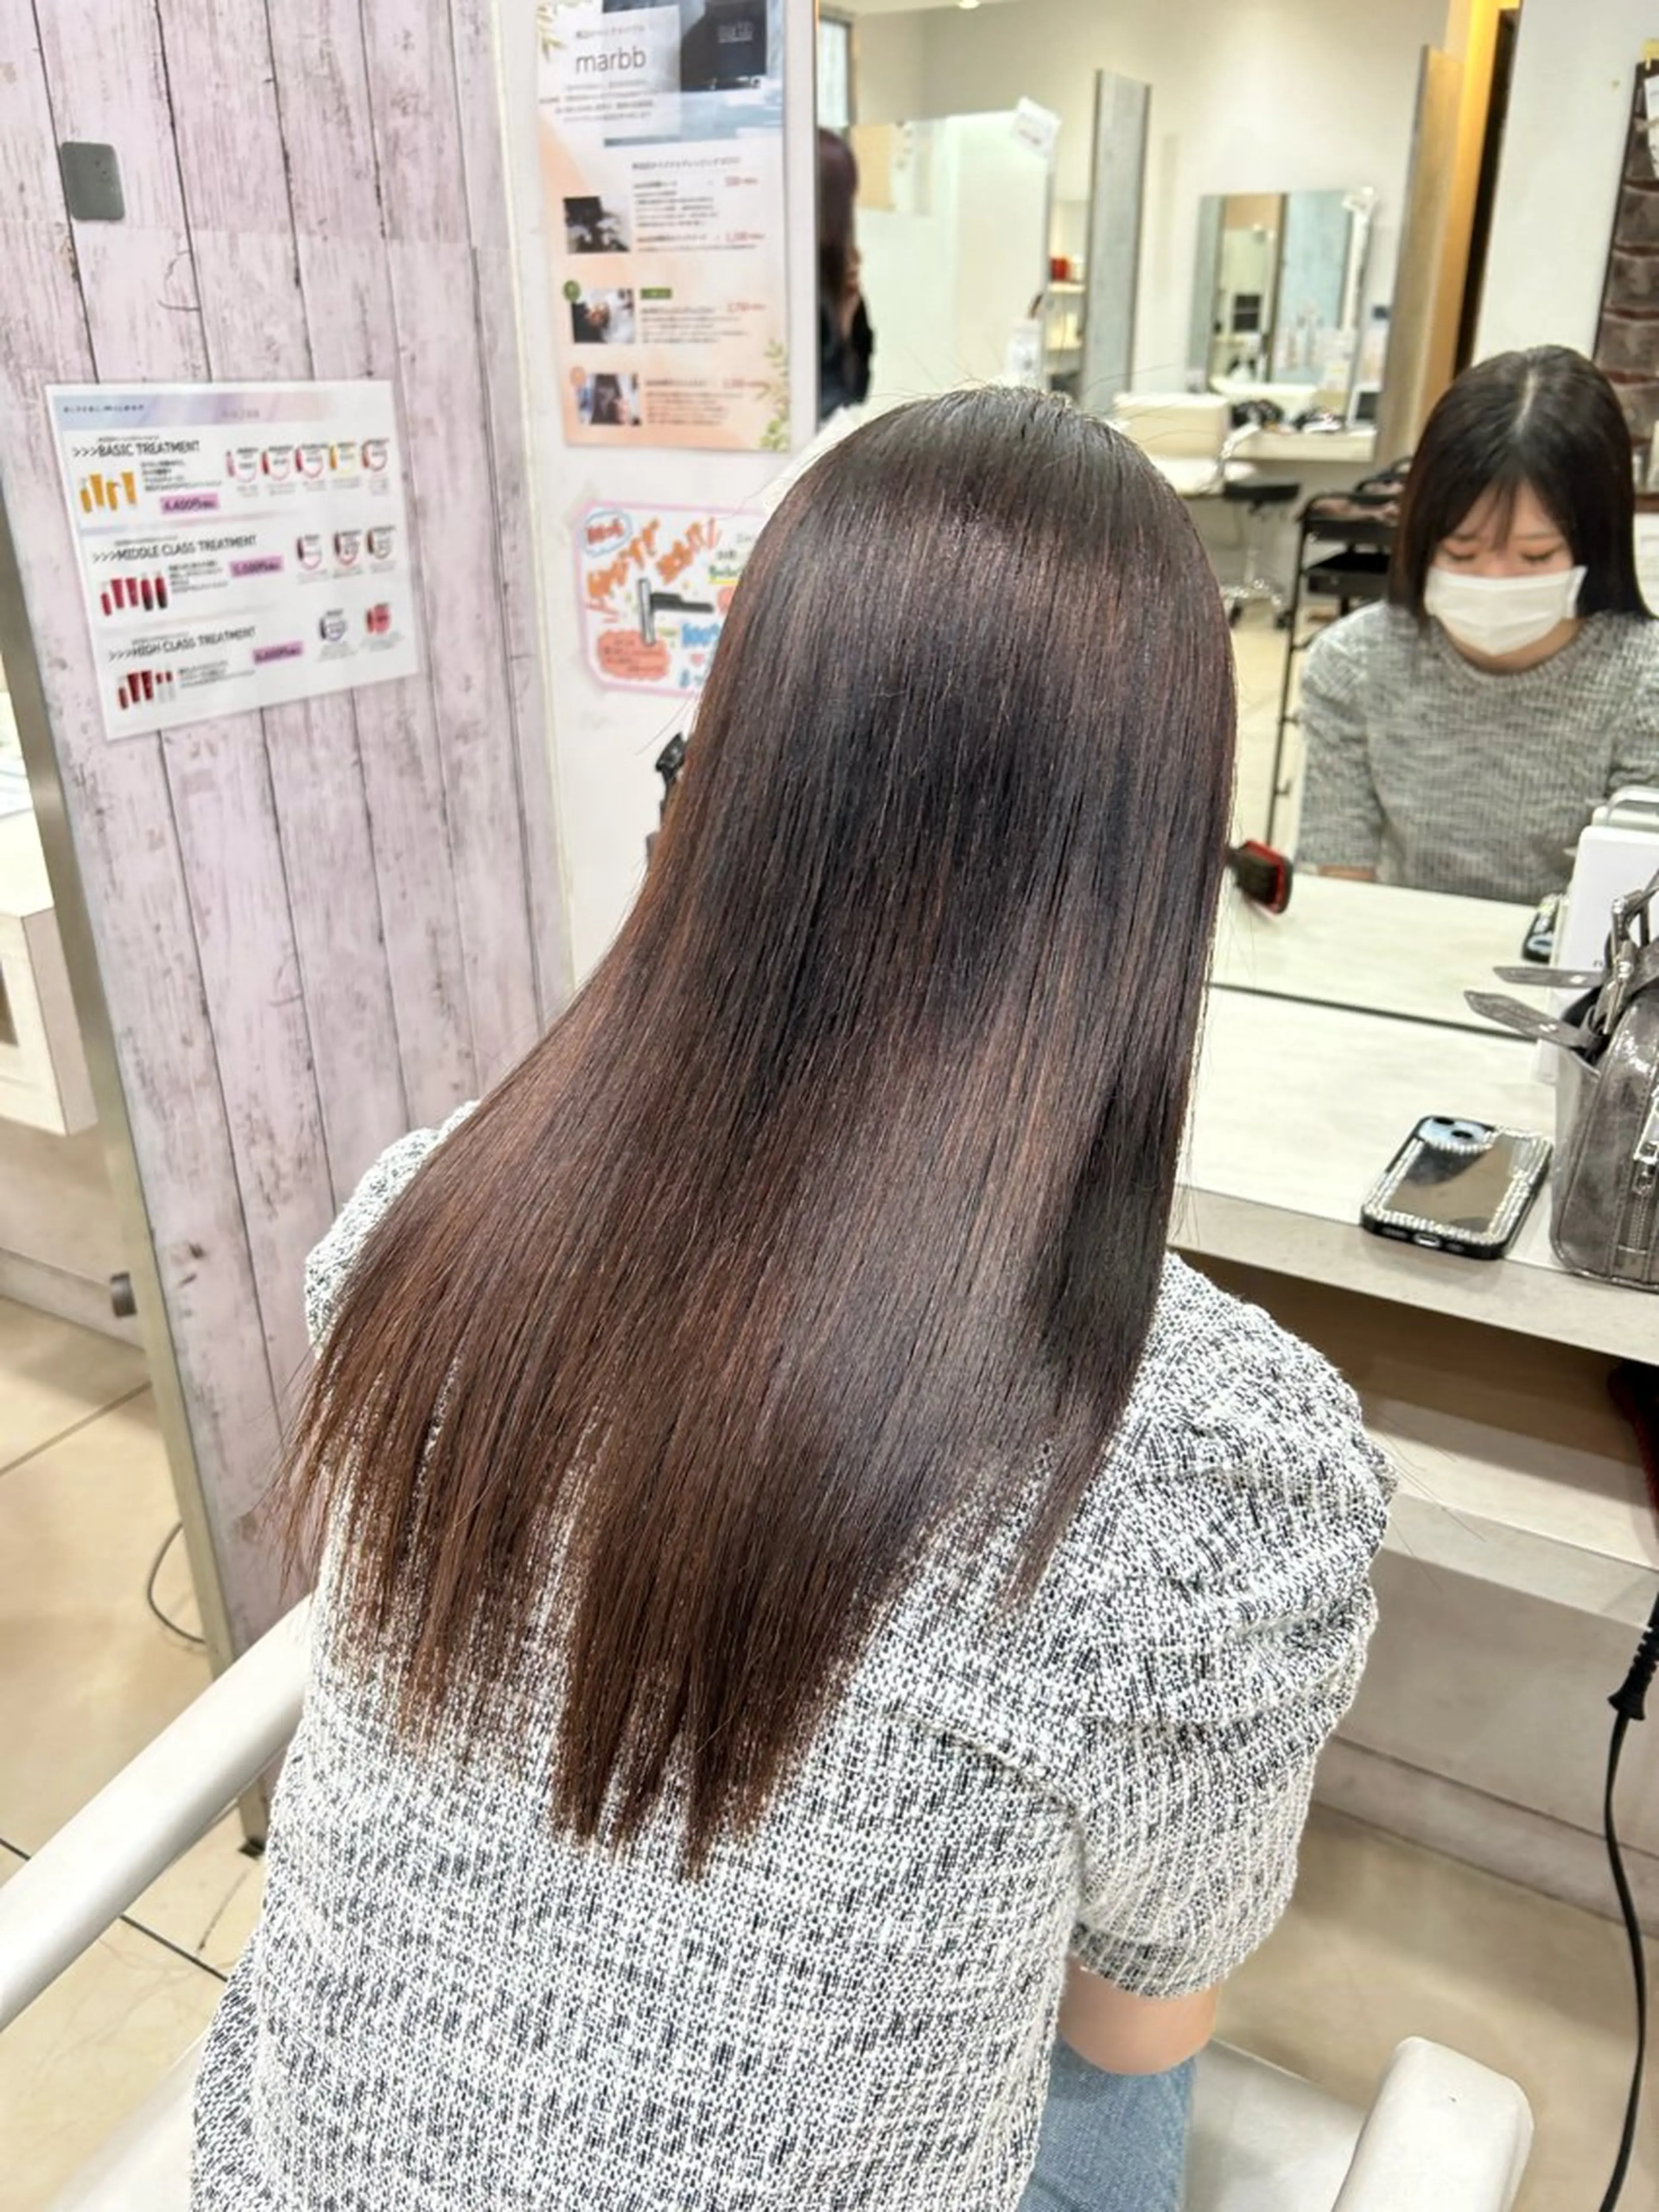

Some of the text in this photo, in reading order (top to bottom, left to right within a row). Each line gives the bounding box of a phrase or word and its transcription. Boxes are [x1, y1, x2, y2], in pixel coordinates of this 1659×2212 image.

[575, 45, 647, 75] marbb
[98, 440, 200, 458] BASIC TREATMENT
[161, 542, 196, 556] CLASS
[198, 535, 257, 552] TREATMENT
[132, 643, 161, 657] HIGH
[162, 638, 197, 652] CLASS
[197, 626, 256, 646] TREATMENT
